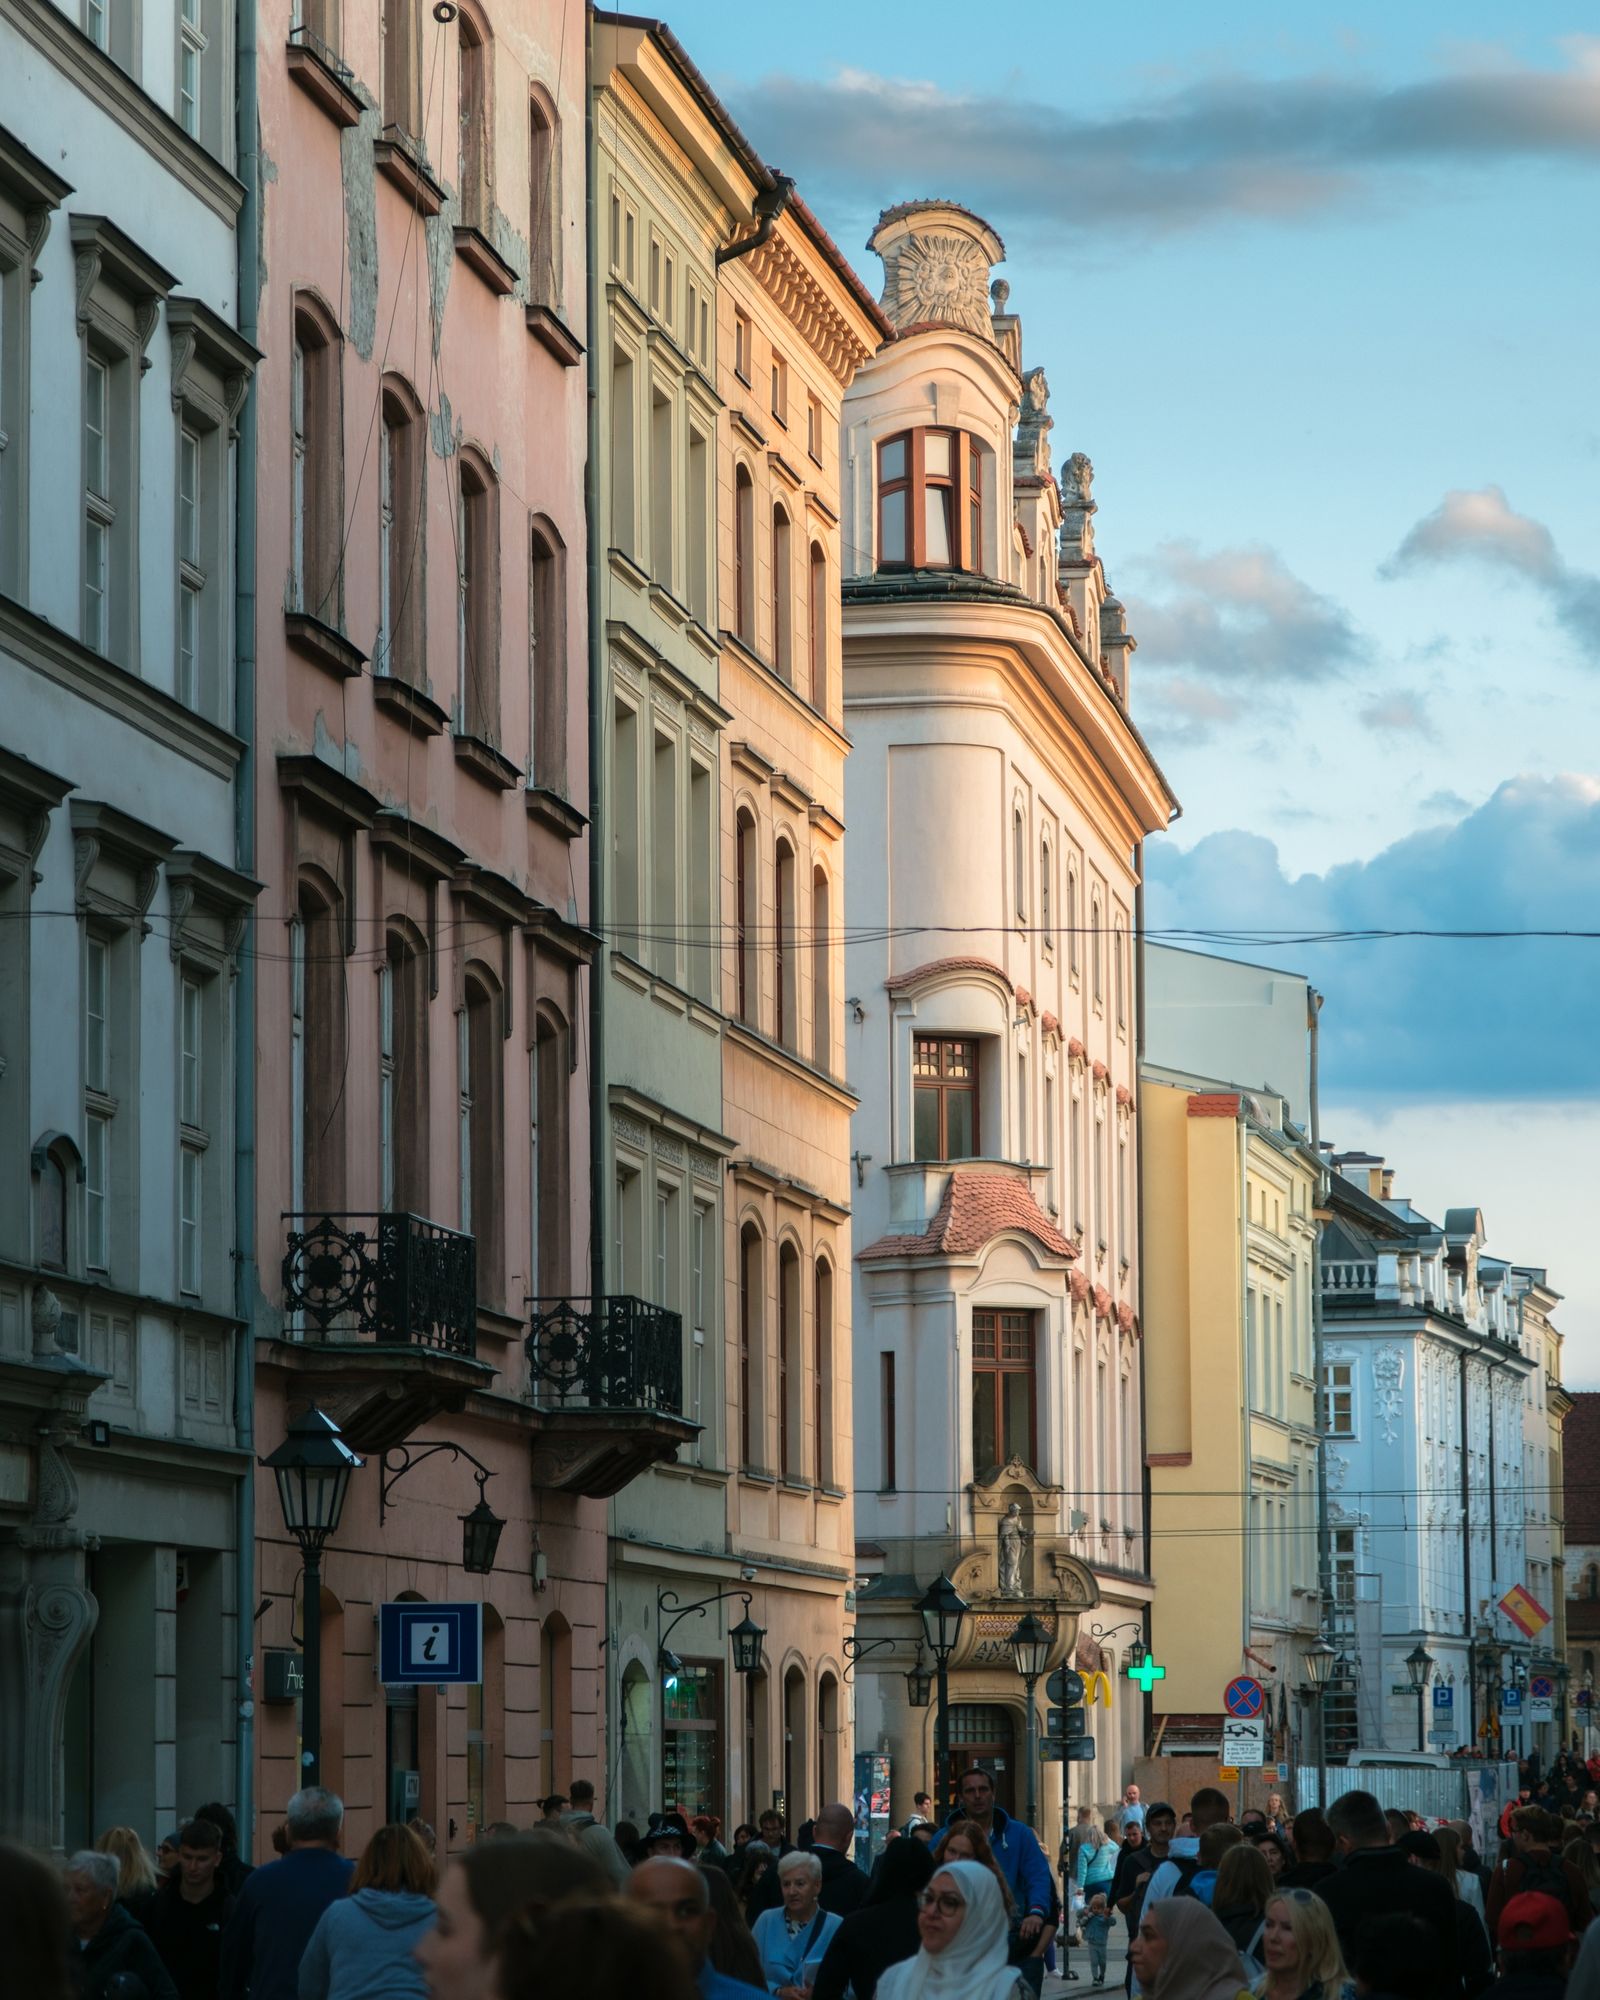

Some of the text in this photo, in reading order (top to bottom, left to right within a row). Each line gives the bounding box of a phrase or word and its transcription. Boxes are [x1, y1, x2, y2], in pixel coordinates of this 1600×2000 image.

[971, 1652, 1014, 1663] SUS
[1438, 1690, 1449, 1705] P
[1507, 1691, 1517, 1704] P
